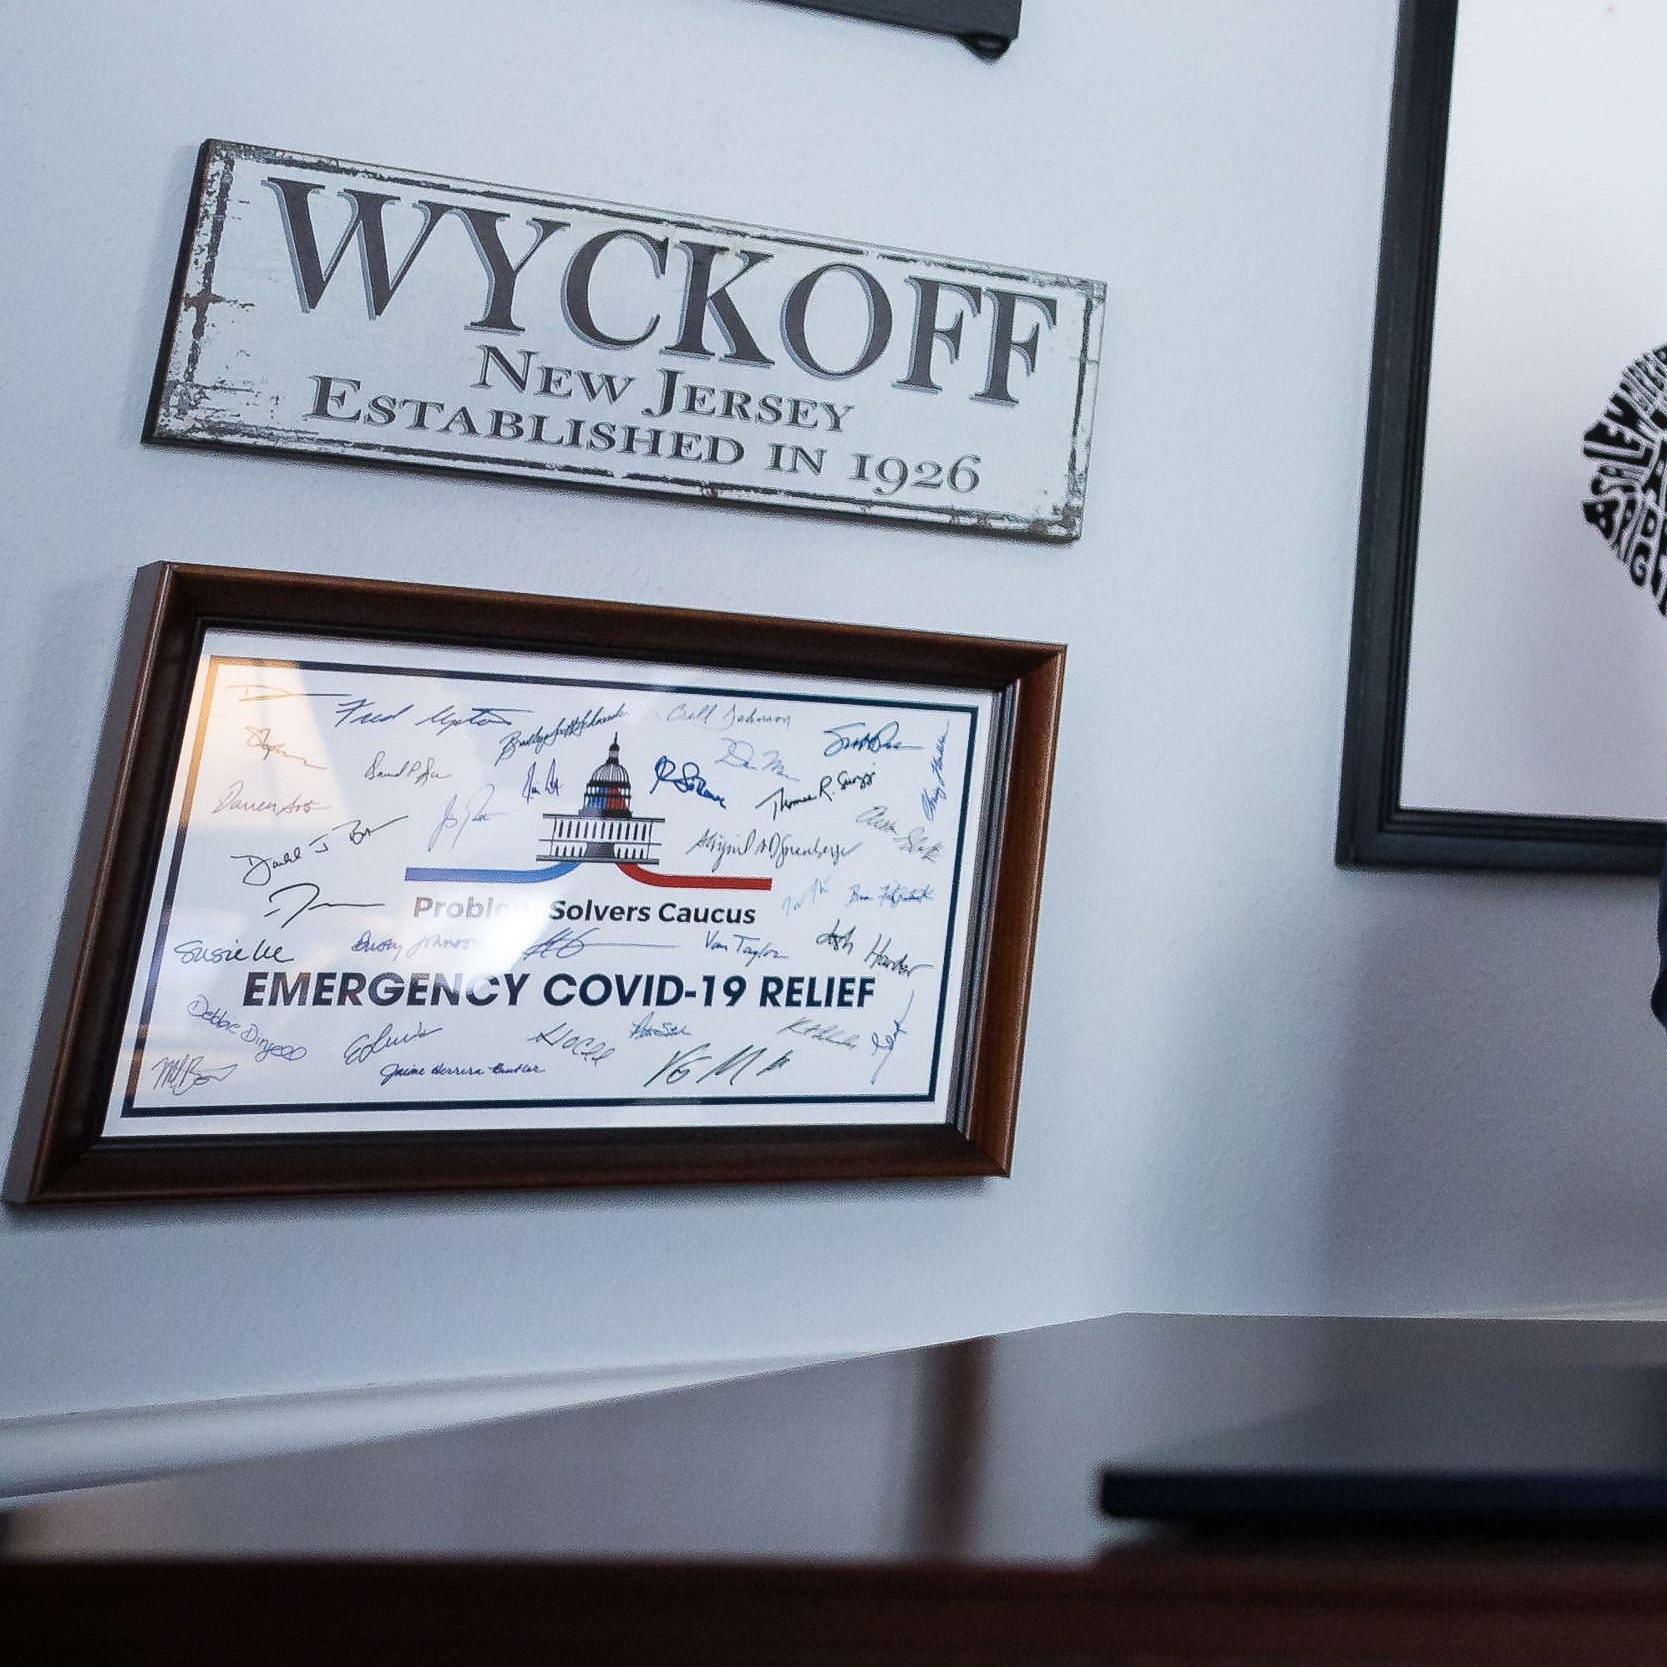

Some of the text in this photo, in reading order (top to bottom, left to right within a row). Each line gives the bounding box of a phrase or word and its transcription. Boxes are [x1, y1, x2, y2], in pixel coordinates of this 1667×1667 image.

[262, 174, 1059, 412] WYCKOFF
[847, 453, 983, 498] 1926
[548, 899, 651, 924] Solvers
[657, 901, 757, 926] Caucus
[241, 970, 877, 1008] EMERGENCY COVID-19 RELIEF
